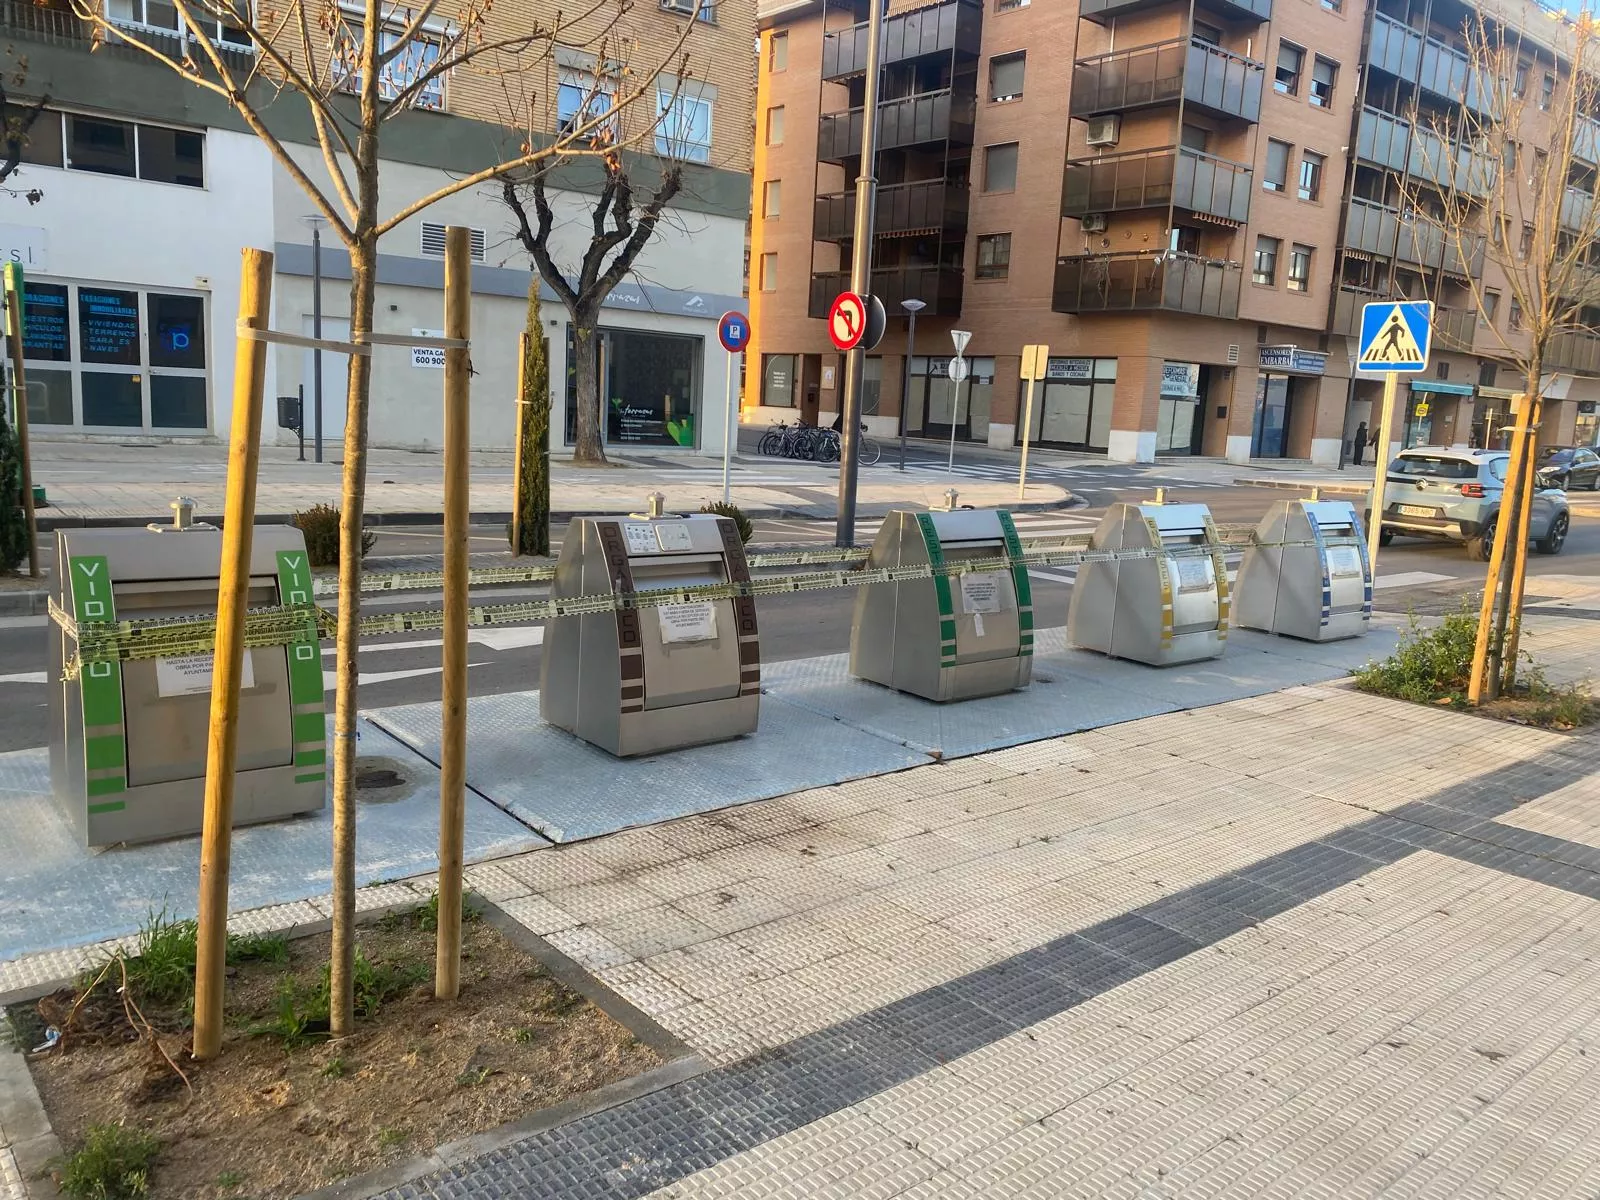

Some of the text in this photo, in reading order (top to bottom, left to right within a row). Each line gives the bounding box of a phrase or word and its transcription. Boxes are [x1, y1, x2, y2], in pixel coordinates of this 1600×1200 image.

[413, 348, 434, 356] VENTA
[415, 356, 430, 364] 600
[1260, 356, 1291, 366] EMBARBA
[78, 562, 112, 678] VIDO
